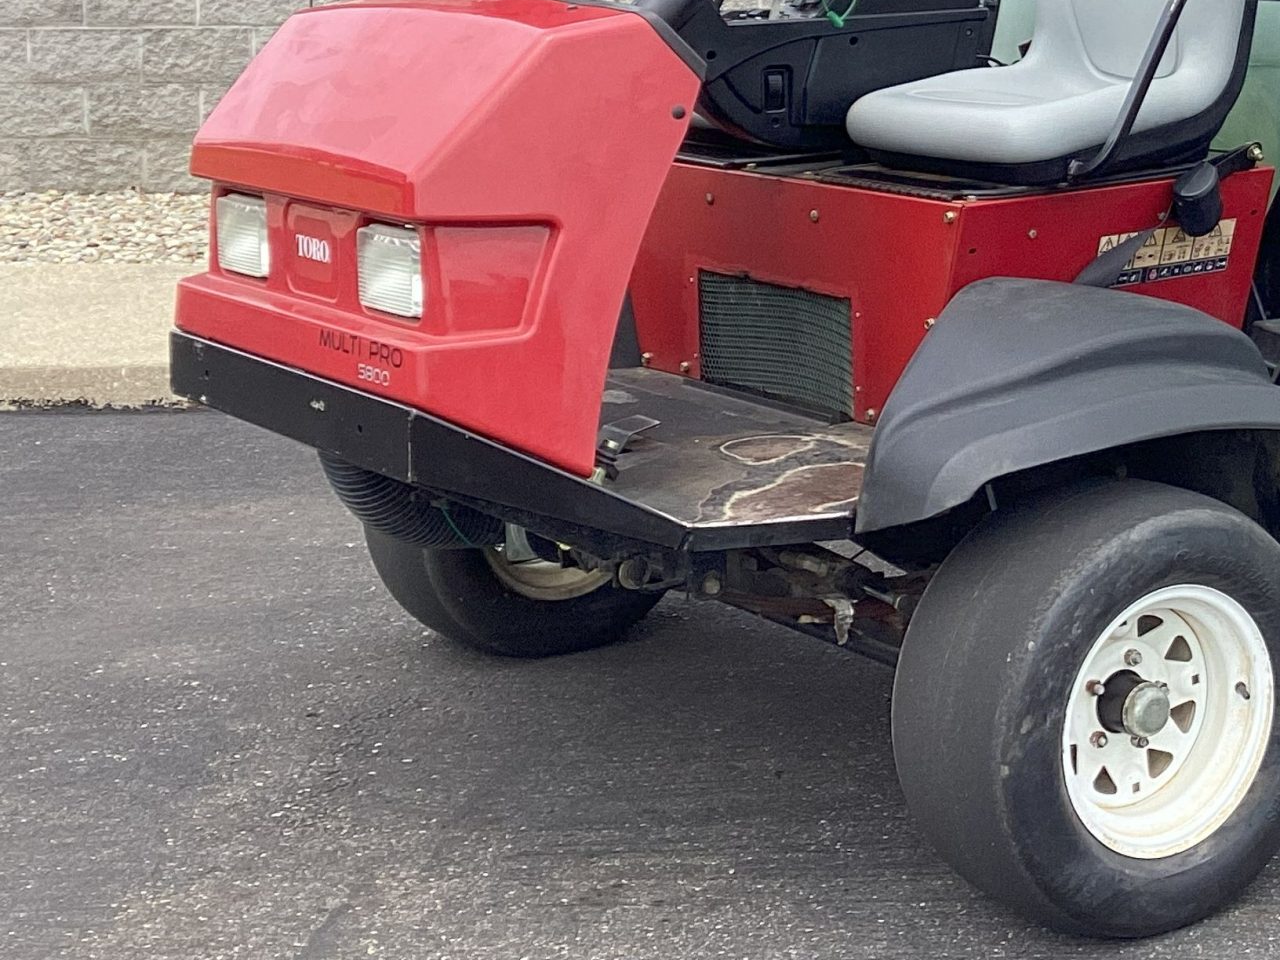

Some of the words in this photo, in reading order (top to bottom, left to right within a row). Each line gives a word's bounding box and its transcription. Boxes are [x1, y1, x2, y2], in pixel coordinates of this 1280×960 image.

[295, 234, 330, 263] TORO
[319, 328, 361, 357] MULTI
[368, 341, 404, 369] PRO
[357, 363, 390, 386] 5800
